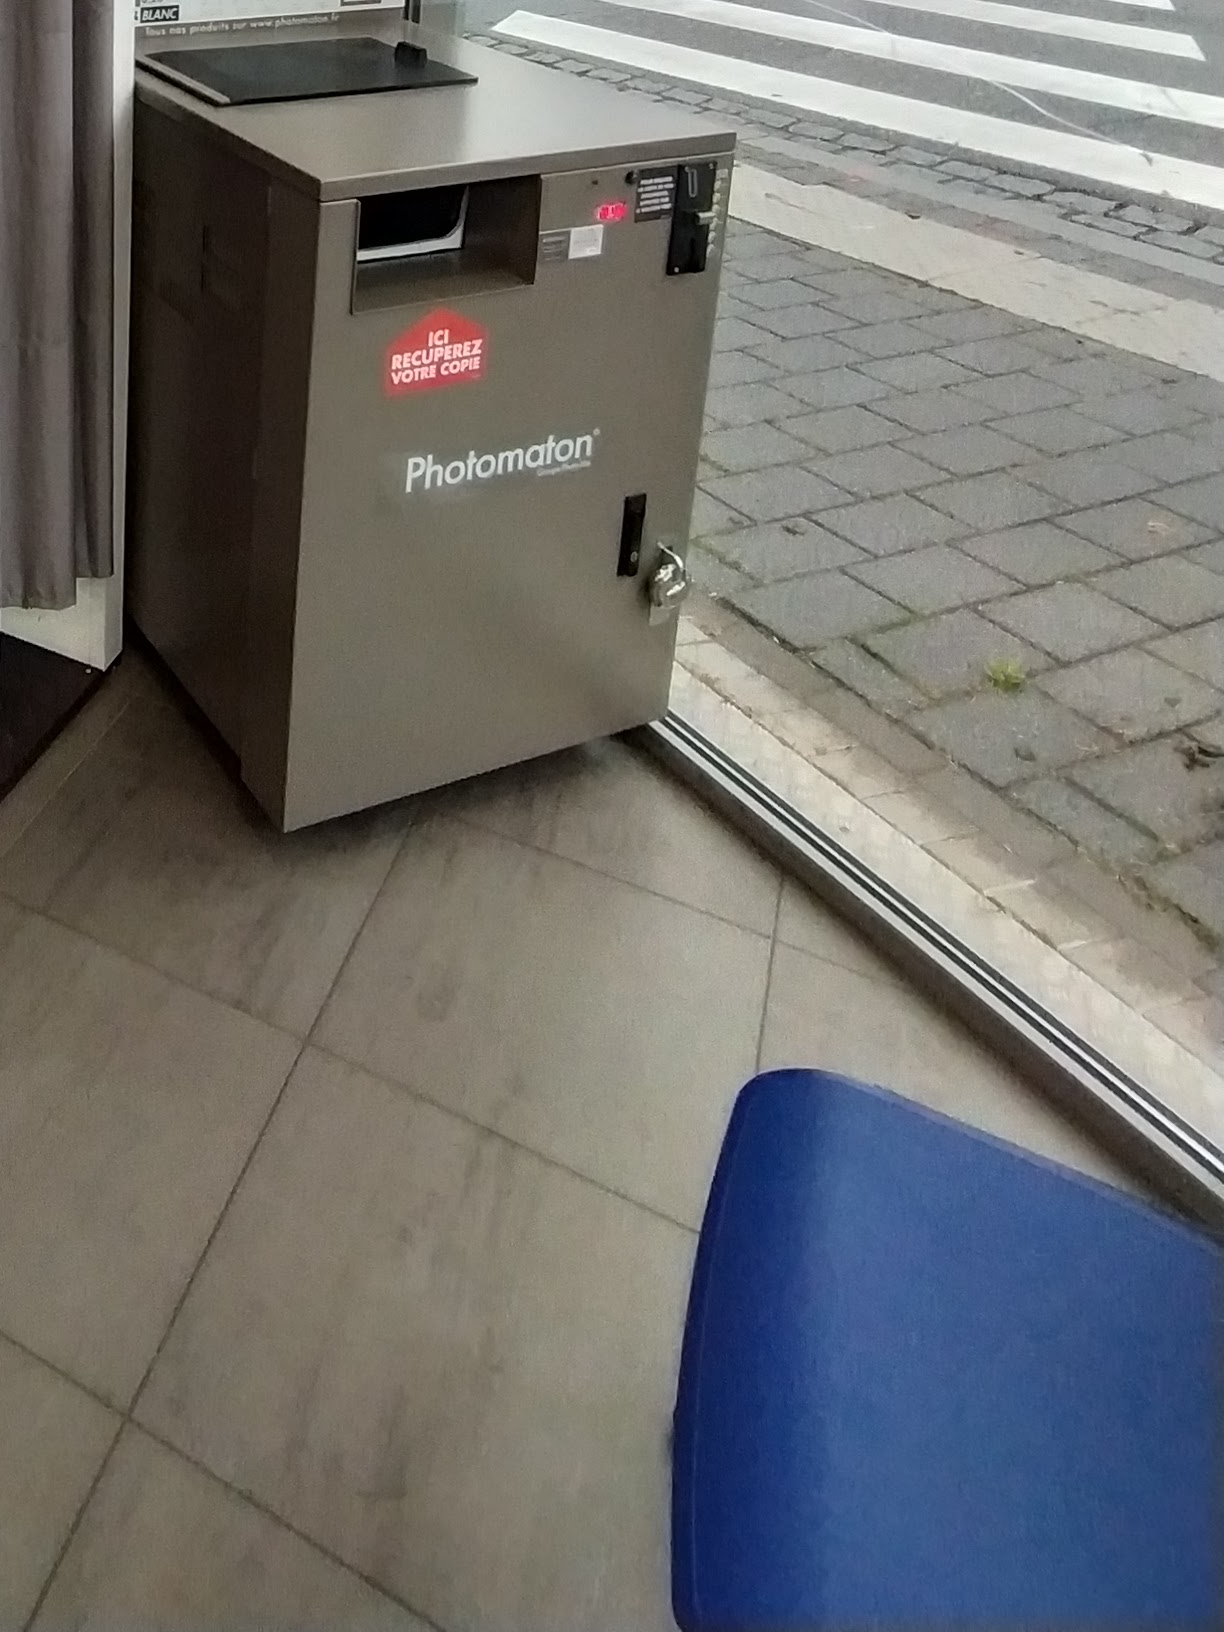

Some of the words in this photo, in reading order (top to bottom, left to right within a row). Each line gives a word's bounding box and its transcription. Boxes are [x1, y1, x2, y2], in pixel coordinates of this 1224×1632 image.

[142, 8, 177, 22] BLANC
[428, 328, 450, 347] ICI
[391, 339, 483, 370] RECUPEREZ
[391, 365, 436, 385] VOTRE
[440, 357, 481, 376] COPIE
